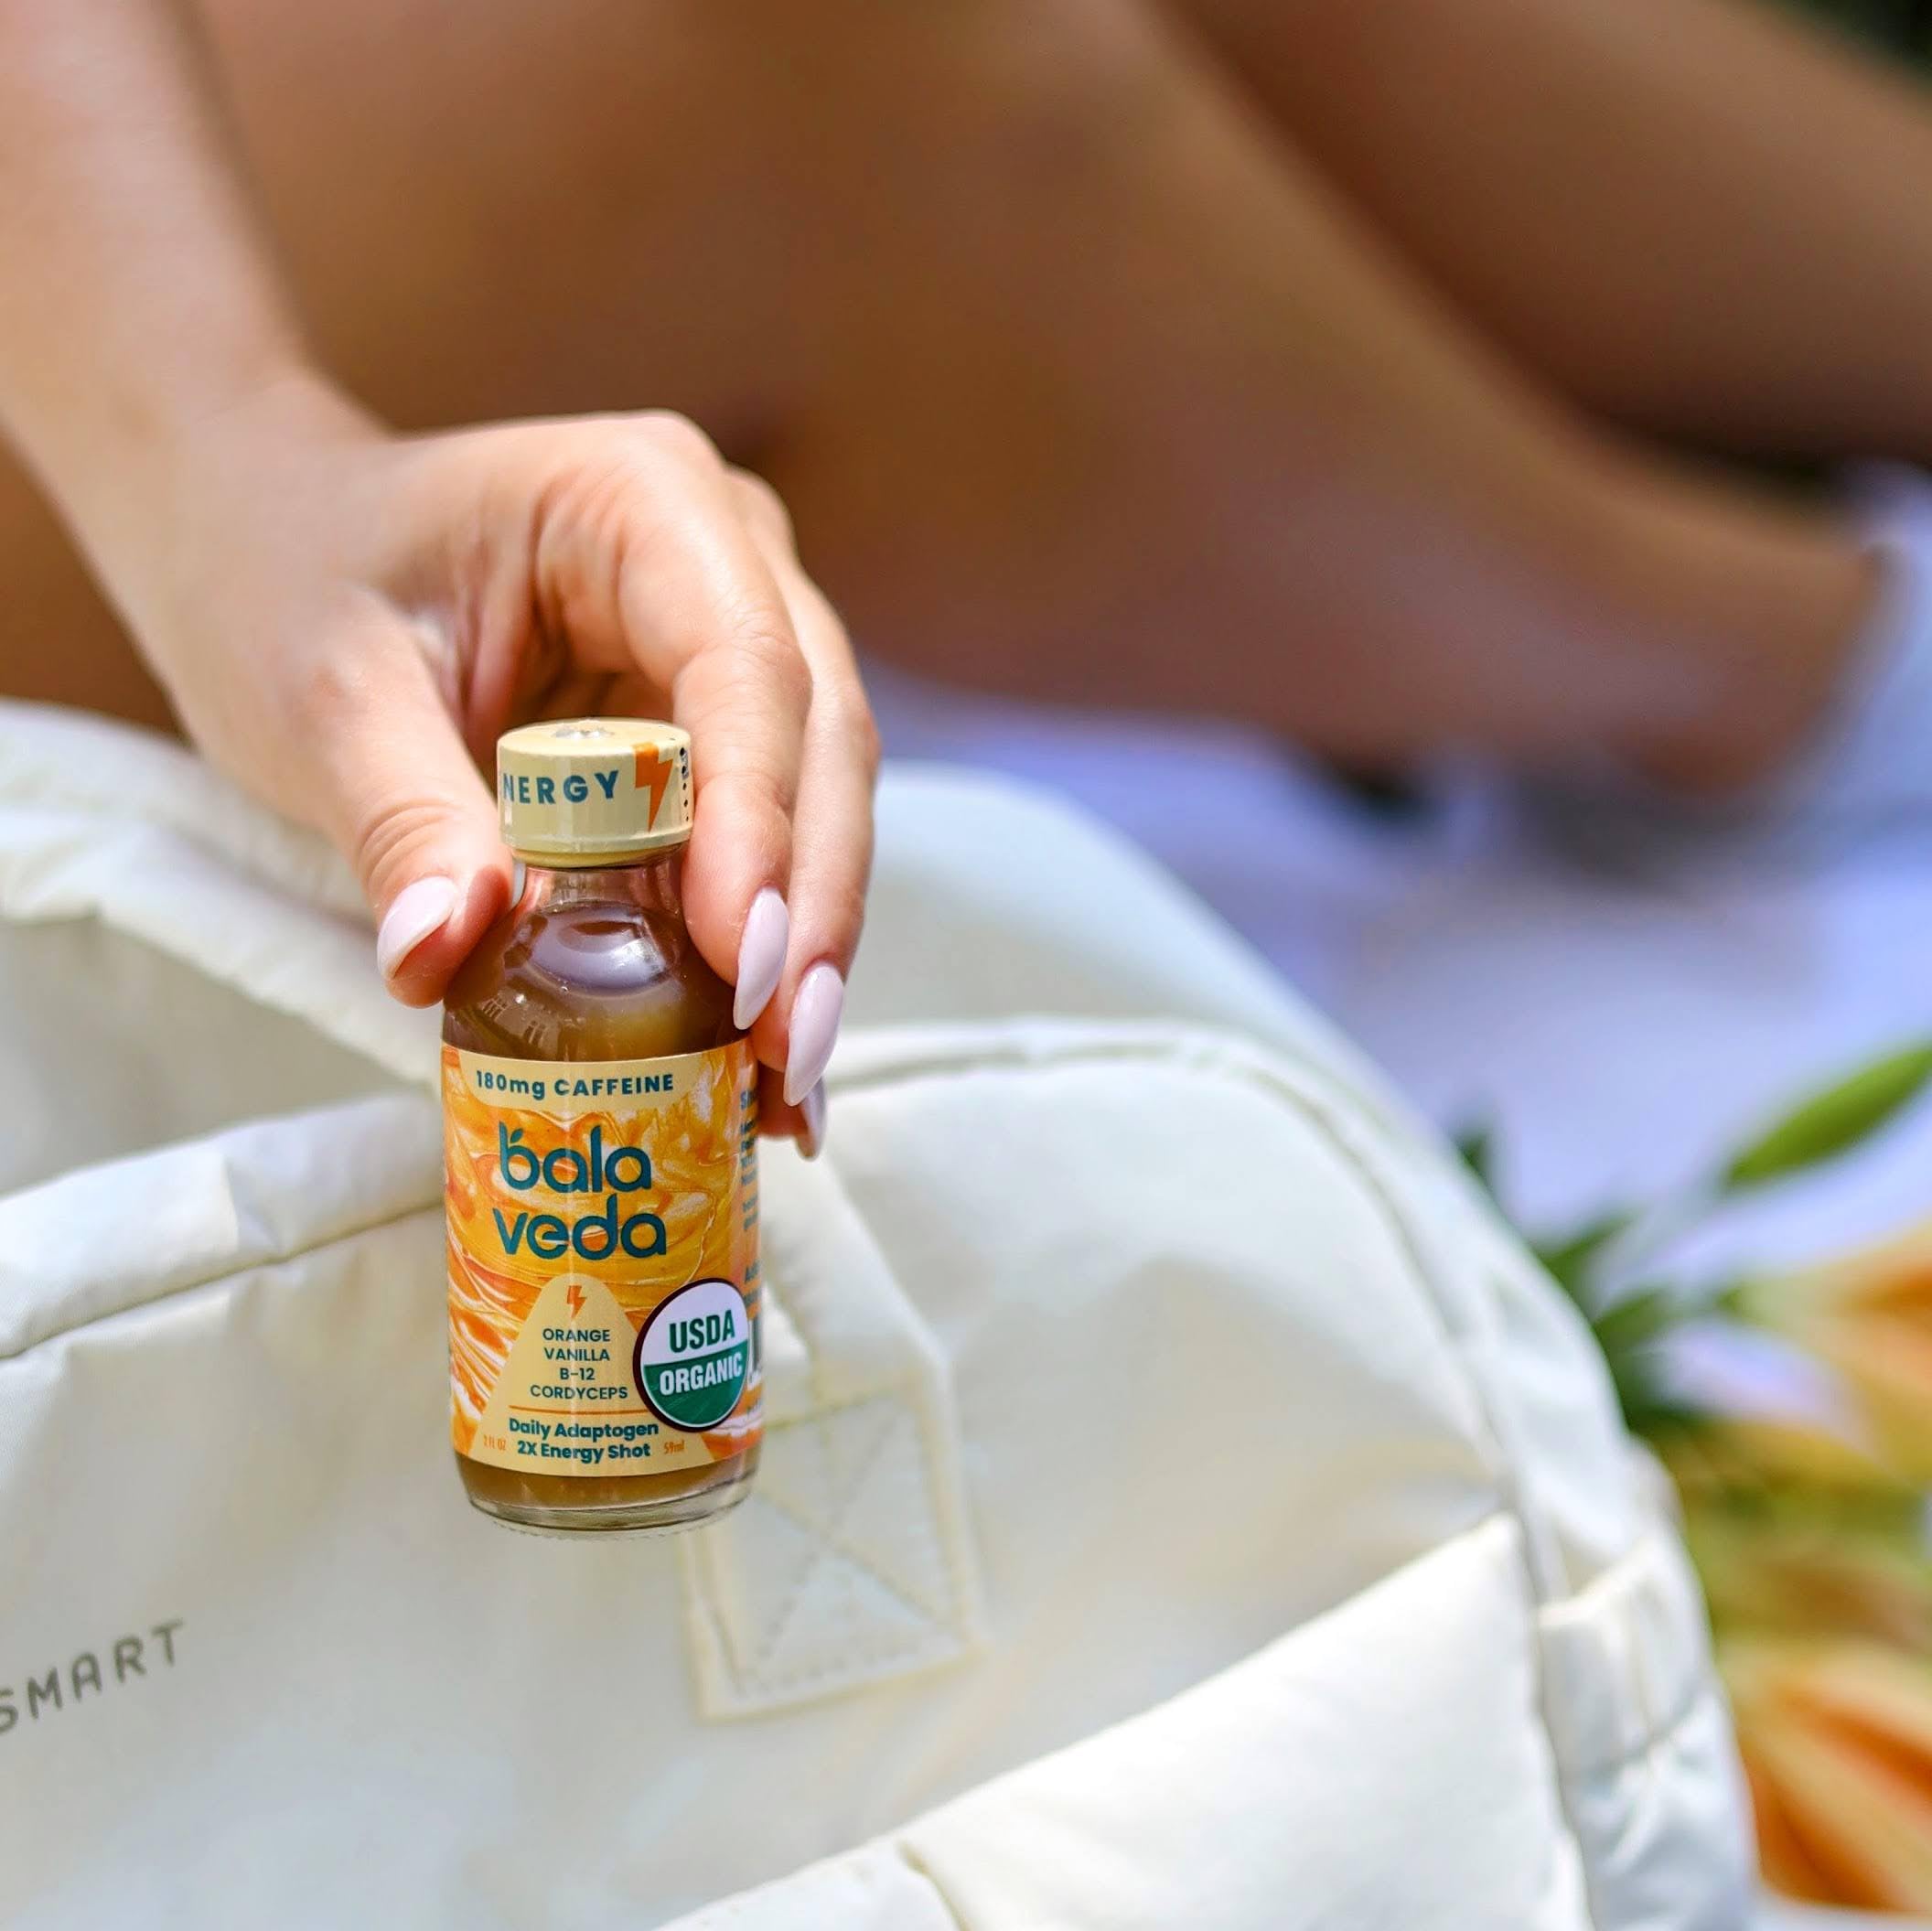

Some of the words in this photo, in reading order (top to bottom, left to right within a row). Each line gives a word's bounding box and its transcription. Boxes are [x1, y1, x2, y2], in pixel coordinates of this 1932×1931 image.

[503, 769, 619, 805] NERGY
[476, 1069, 545, 1100] 180mg
[553, 1073, 674, 1097] CAFFEINE
[499, 1121, 652, 1194] bala
[492, 1193, 667, 1261] veda
[542, 1327, 611, 1343] ORANGE
[669, 1309, 735, 1354] USDA
[543, 1346, 610, 1362] VANILLA
[559, 1367, 596, 1381] B-12
[659, 1351, 743, 1397] ORGANIC
[530, 1384, 628, 1400] CORDYCEPS
[509, 1418, 551, 1441] Daily
[554, 1422, 660, 1443] Adaptogen
[517, 1440, 538, 1457] 2X
[541, 1443, 605, 1464] Energy
[607, 1442, 651, 1460] Shot
[0, 1616, 186, 1736] SMART
